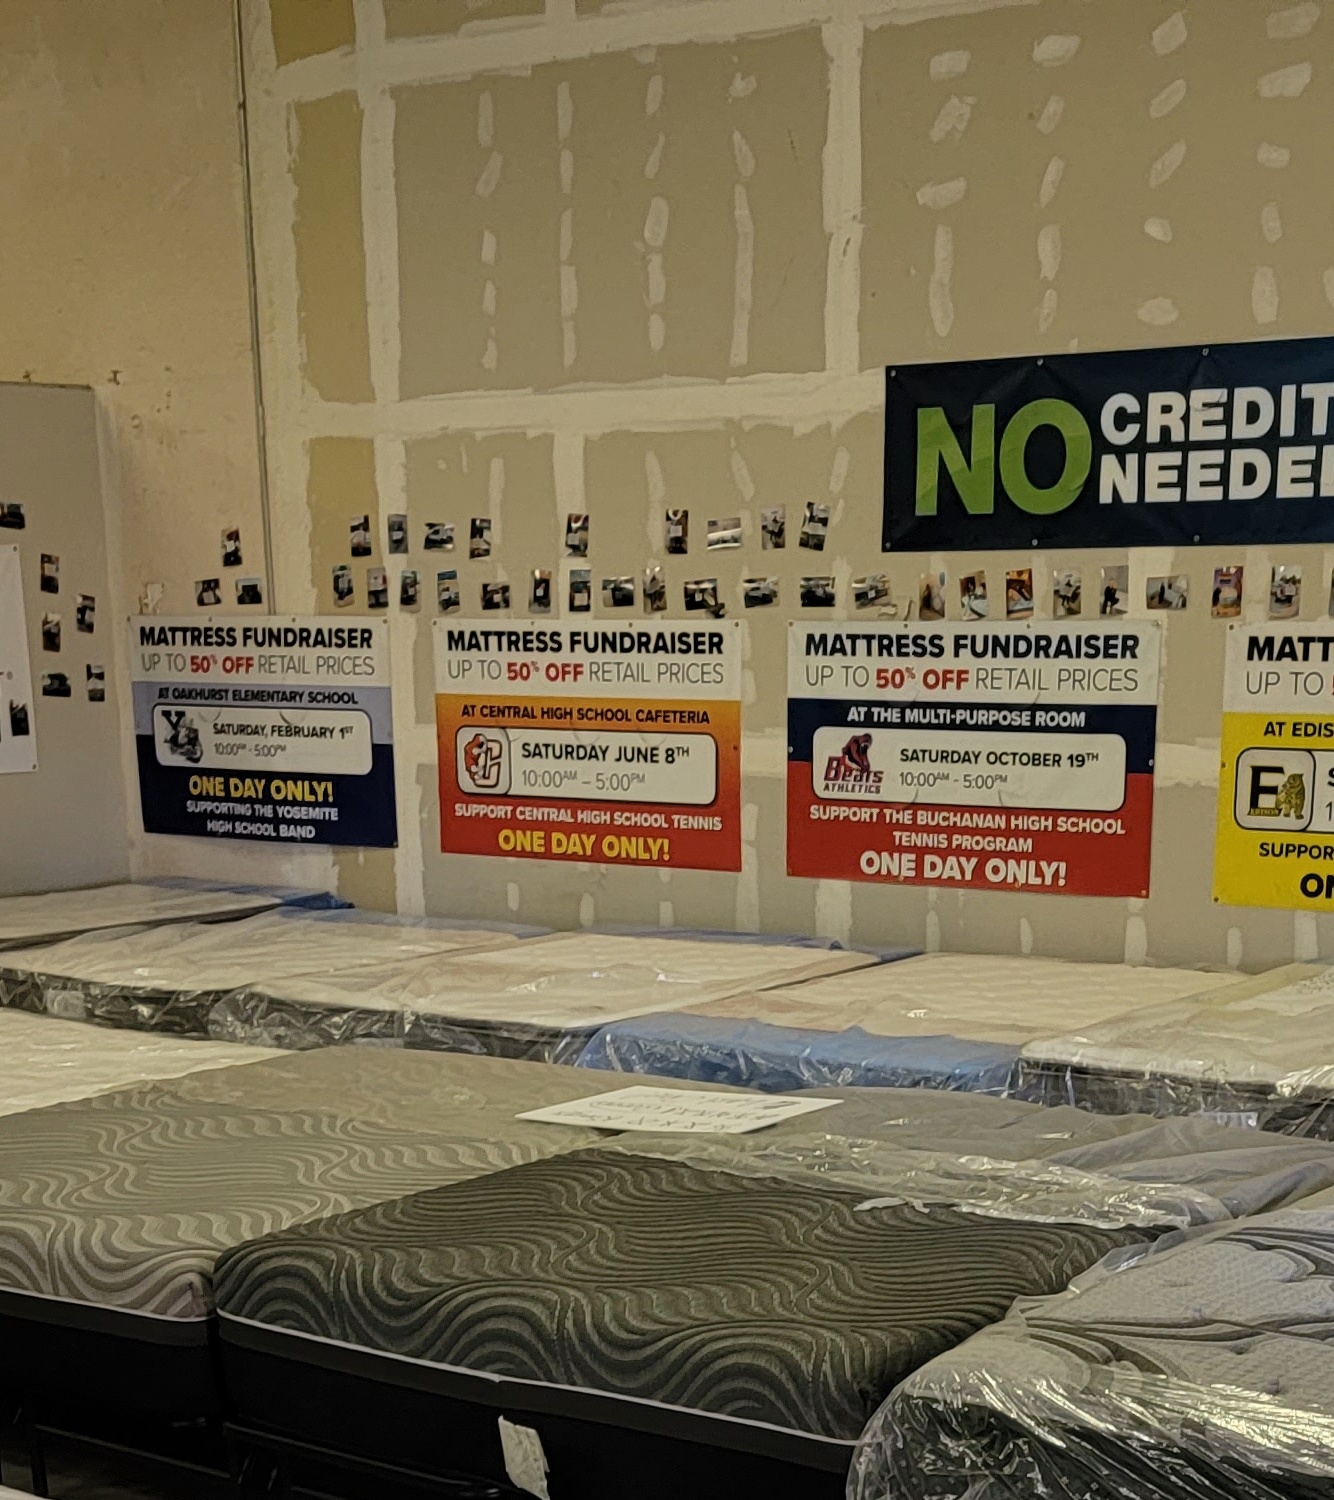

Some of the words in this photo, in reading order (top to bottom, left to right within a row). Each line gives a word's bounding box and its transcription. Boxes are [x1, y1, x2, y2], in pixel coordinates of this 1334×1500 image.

[915, 398, 1092, 516] NO
[140, 626, 237, 647] MATTRESS
[243, 628, 372, 649] FUNDRAISER
[447, 631, 562, 652] MATTRESS
[569, 631, 723, 654] FUNDRAISER
[805, 633, 945, 658] MATTRESS
[953, 634, 1140, 660] FUNDRAISER
[142, 654, 161, 671] UP
[167, 653, 186, 672] TO
[222, 657, 254, 674] OFF
[258, 655, 311, 675] RETAIL
[316, 656, 375, 675] PRICES
[447, 660, 472, 679] UP
[480, 660, 501, 680] TO
[507, 661, 540, 681] 50%
[545, 662, 584, 683] OFF
[589, 662, 651, 683] RETAIL
[657, 663, 723, 684] PRICES
[805, 665, 834, 687] UP
[841, 666, 869, 687] TO
[875, 667, 917, 689] 50%
[922, 669, 969, 690] OFF
[975, 668, 1049, 691] RETAIL
[1057, 668, 1139, 691] PRICES
[1245, 671, 1281, 696] UP
[1291, 671, 1325, 697] TO
[172, 687, 228, 701] OAKHURST
[232, 690, 304, 703] ELEMENTARY
[307, 691, 358, 704] SCHOOL
[462, 705, 476, 718] AT
[480, 705, 537, 719] CENTRAL
[541, 707, 573, 720] HIGH
[576, 708, 632, 722] SCHOOL
[635, 709, 710, 724] CAFETERIA
[847, 706, 868, 722] AT
[870, 707, 901, 723] THE
[905, 708, 1031, 726] MULTI-PURPOSE
[1034, 711, 1086, 727] ROOM
[271, 725, 334, 739] FEBRUARY
[1263, 721, 1287, 737] AT
[522, 743, 610, 761] SATURDAY
[614, 746, 660, 763] JUNE
[664, 746, 690, 764] 8TH
[899, 748, 981, 766] SATURDAY
[986, 751, 1062, 768] OCTOBER
[1067, 752, 1099, 769] 19TH
[189, 775, 225, 796] ONE
[230, 777, 266, 799] DAY
[271, 780, 333, 802] ONLY!
[522, 770, 578, 788] 10:00AM
[595, 773, 645, 791] 5:00PM
[823, 783, 881, 794] ATHLETICS
[899, 771, 950, 788] 10:00AM
[962, 773, 1008, 790] 5:00PM
[186, 800, 252, 816] SUPPORTING
[254, 803, 273, 817] THE
[276, 804, 338, 821] YOSEMITE
[455, 804, 513, 820] SUPPORT
[516, 807, 574, 824] CENTRAL
[576, 811, 610, 825] HIGH
[613, 812, 669, 828] SCHOOL
[671, 815, 722, 831] TENNIS
[810, 805, 879, 823] SUPPORT
[883, 808, 913, 825] THE
[917, 810, 1007, 830] BUCHANAN
[1010, 814, 1053, 832] HIGH
[1056, 817, 1126, 835] SCHOOL
[207, 819, 232, 833] HIGH
[235, 821, 277, 836] SCHOOL
[279, 824, 316, 838] BAND
[498, 830, 545, 852] ONE
[551, 832, 597, 856] DAY
[602, 836, 670, 860] ONLY!
[893, 831, 949, 849] TENNIS
[952, 834, 1033, 852] PROGRAM
[860, 851, 917, 878] ONE
[923, 855, 978, 882] DAY
[985, 858, 1067, 887] ONLY!
